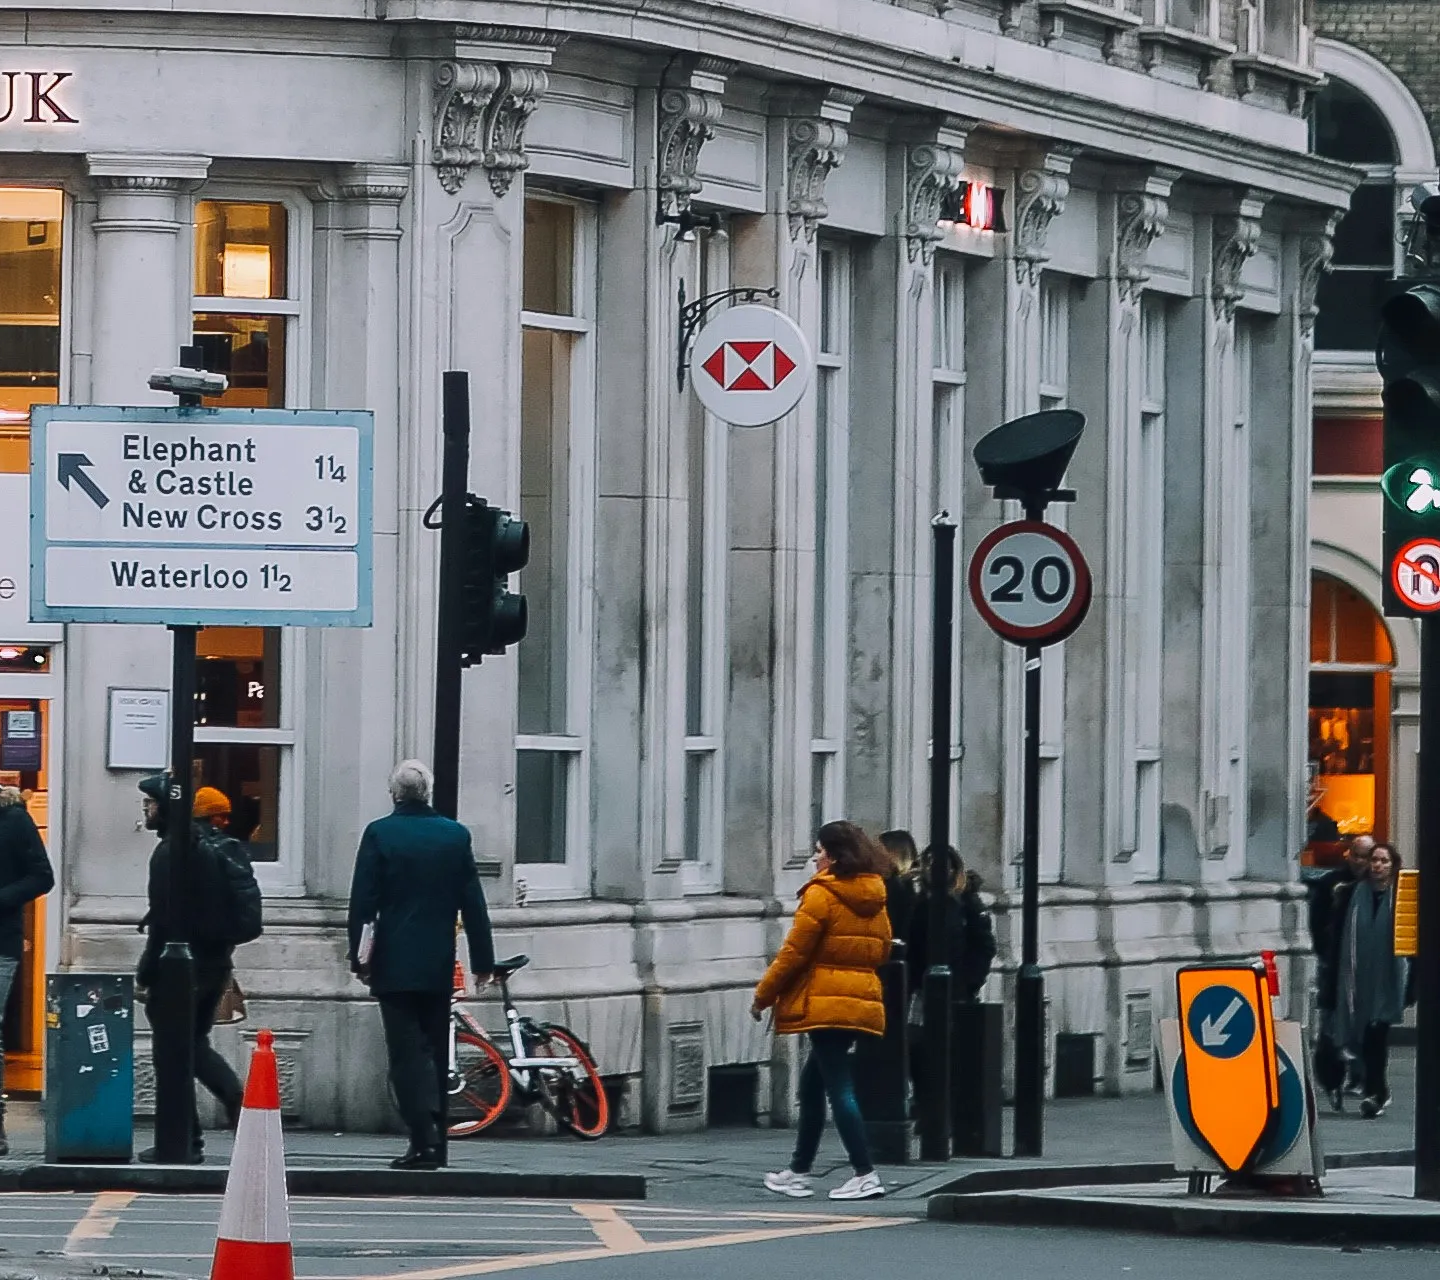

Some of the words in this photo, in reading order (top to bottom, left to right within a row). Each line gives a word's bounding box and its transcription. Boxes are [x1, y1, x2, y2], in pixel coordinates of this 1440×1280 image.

[123, 434, 256, 467] Elephant
[127, 469, 147, 494] &
[156, 469, 253, 496] Castle
[123, 502, 188, 528] New
[197, 504, 282, 531] Cross
[111, 560, 249, 590] Waterloo
[989, 555, 1071, 605] 20
